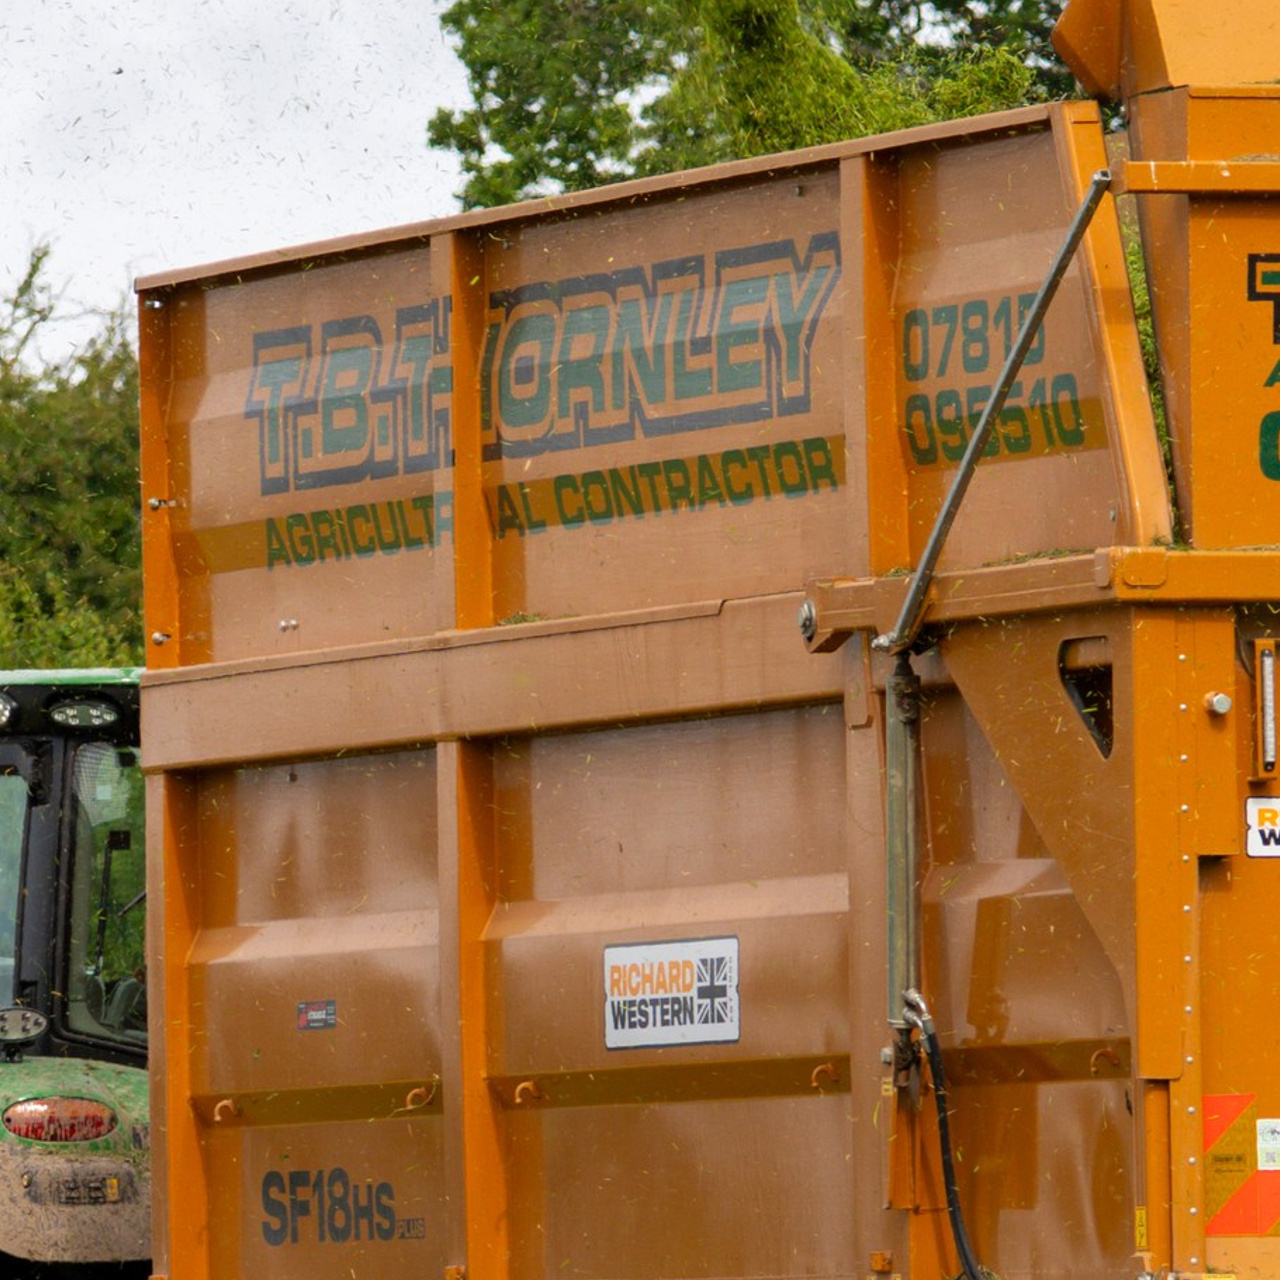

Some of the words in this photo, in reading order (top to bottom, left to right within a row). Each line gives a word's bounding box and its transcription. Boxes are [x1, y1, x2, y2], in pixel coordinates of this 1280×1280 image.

[554, 437, 838, 529] CONTRACTOR
[610, 960, 695, 997] RICHARD
[611, 996, 695, 1030] WESTERN
[261, 1166, 396, 1246] SF18HS
